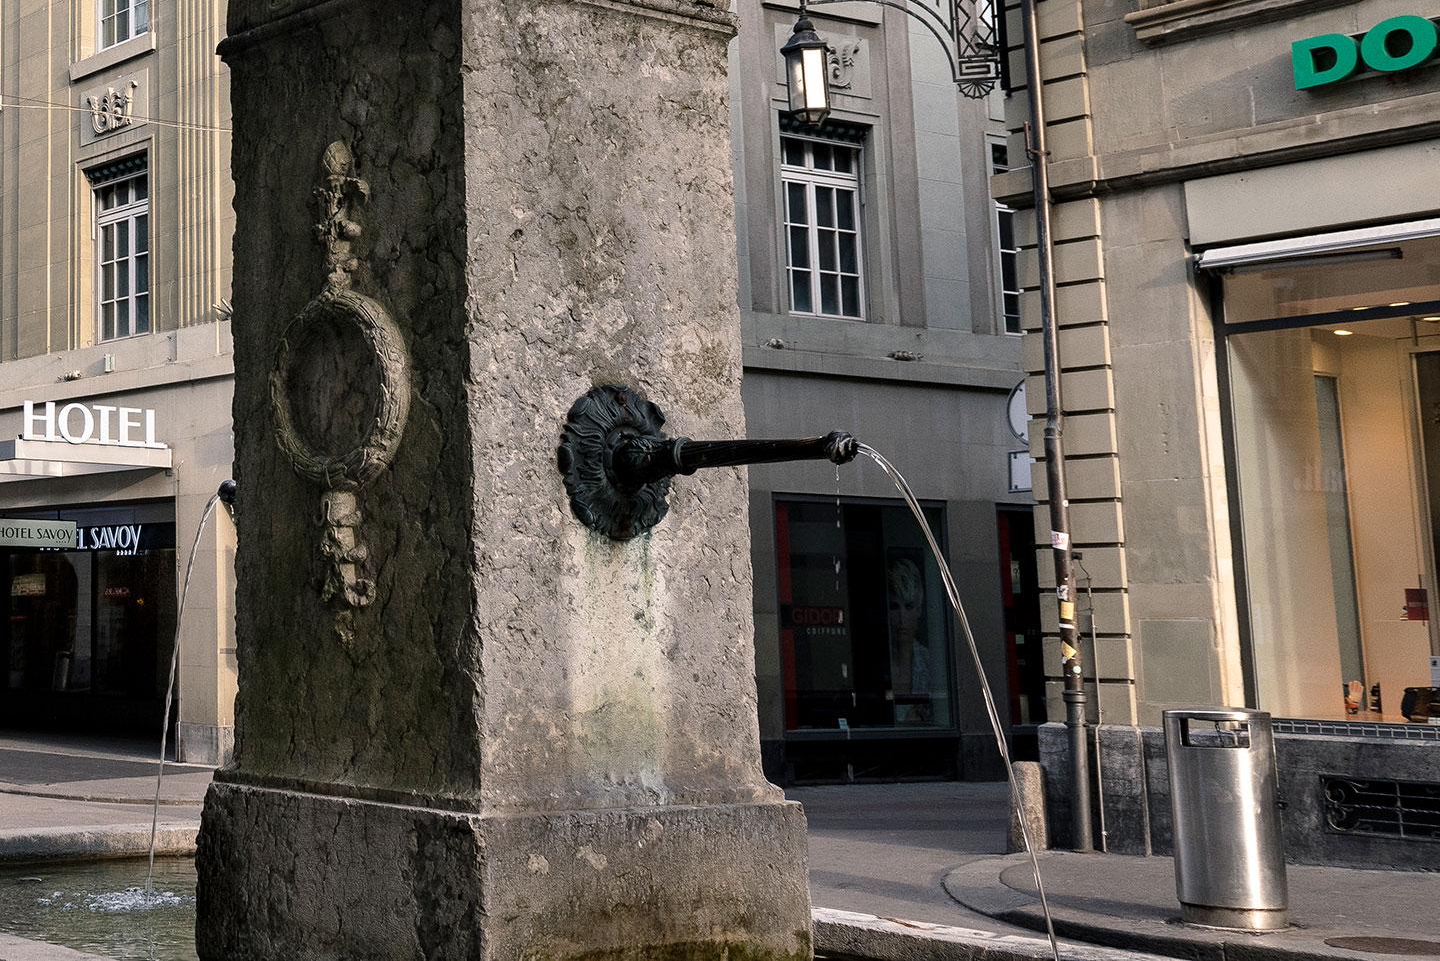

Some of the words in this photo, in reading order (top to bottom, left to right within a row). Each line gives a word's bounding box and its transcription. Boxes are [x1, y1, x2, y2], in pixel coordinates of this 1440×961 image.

[23, 400, 168, 449] HOTEL
[37, 528, 74, 543] SAVOY
[91, 525, 142, 555] SAVOY
